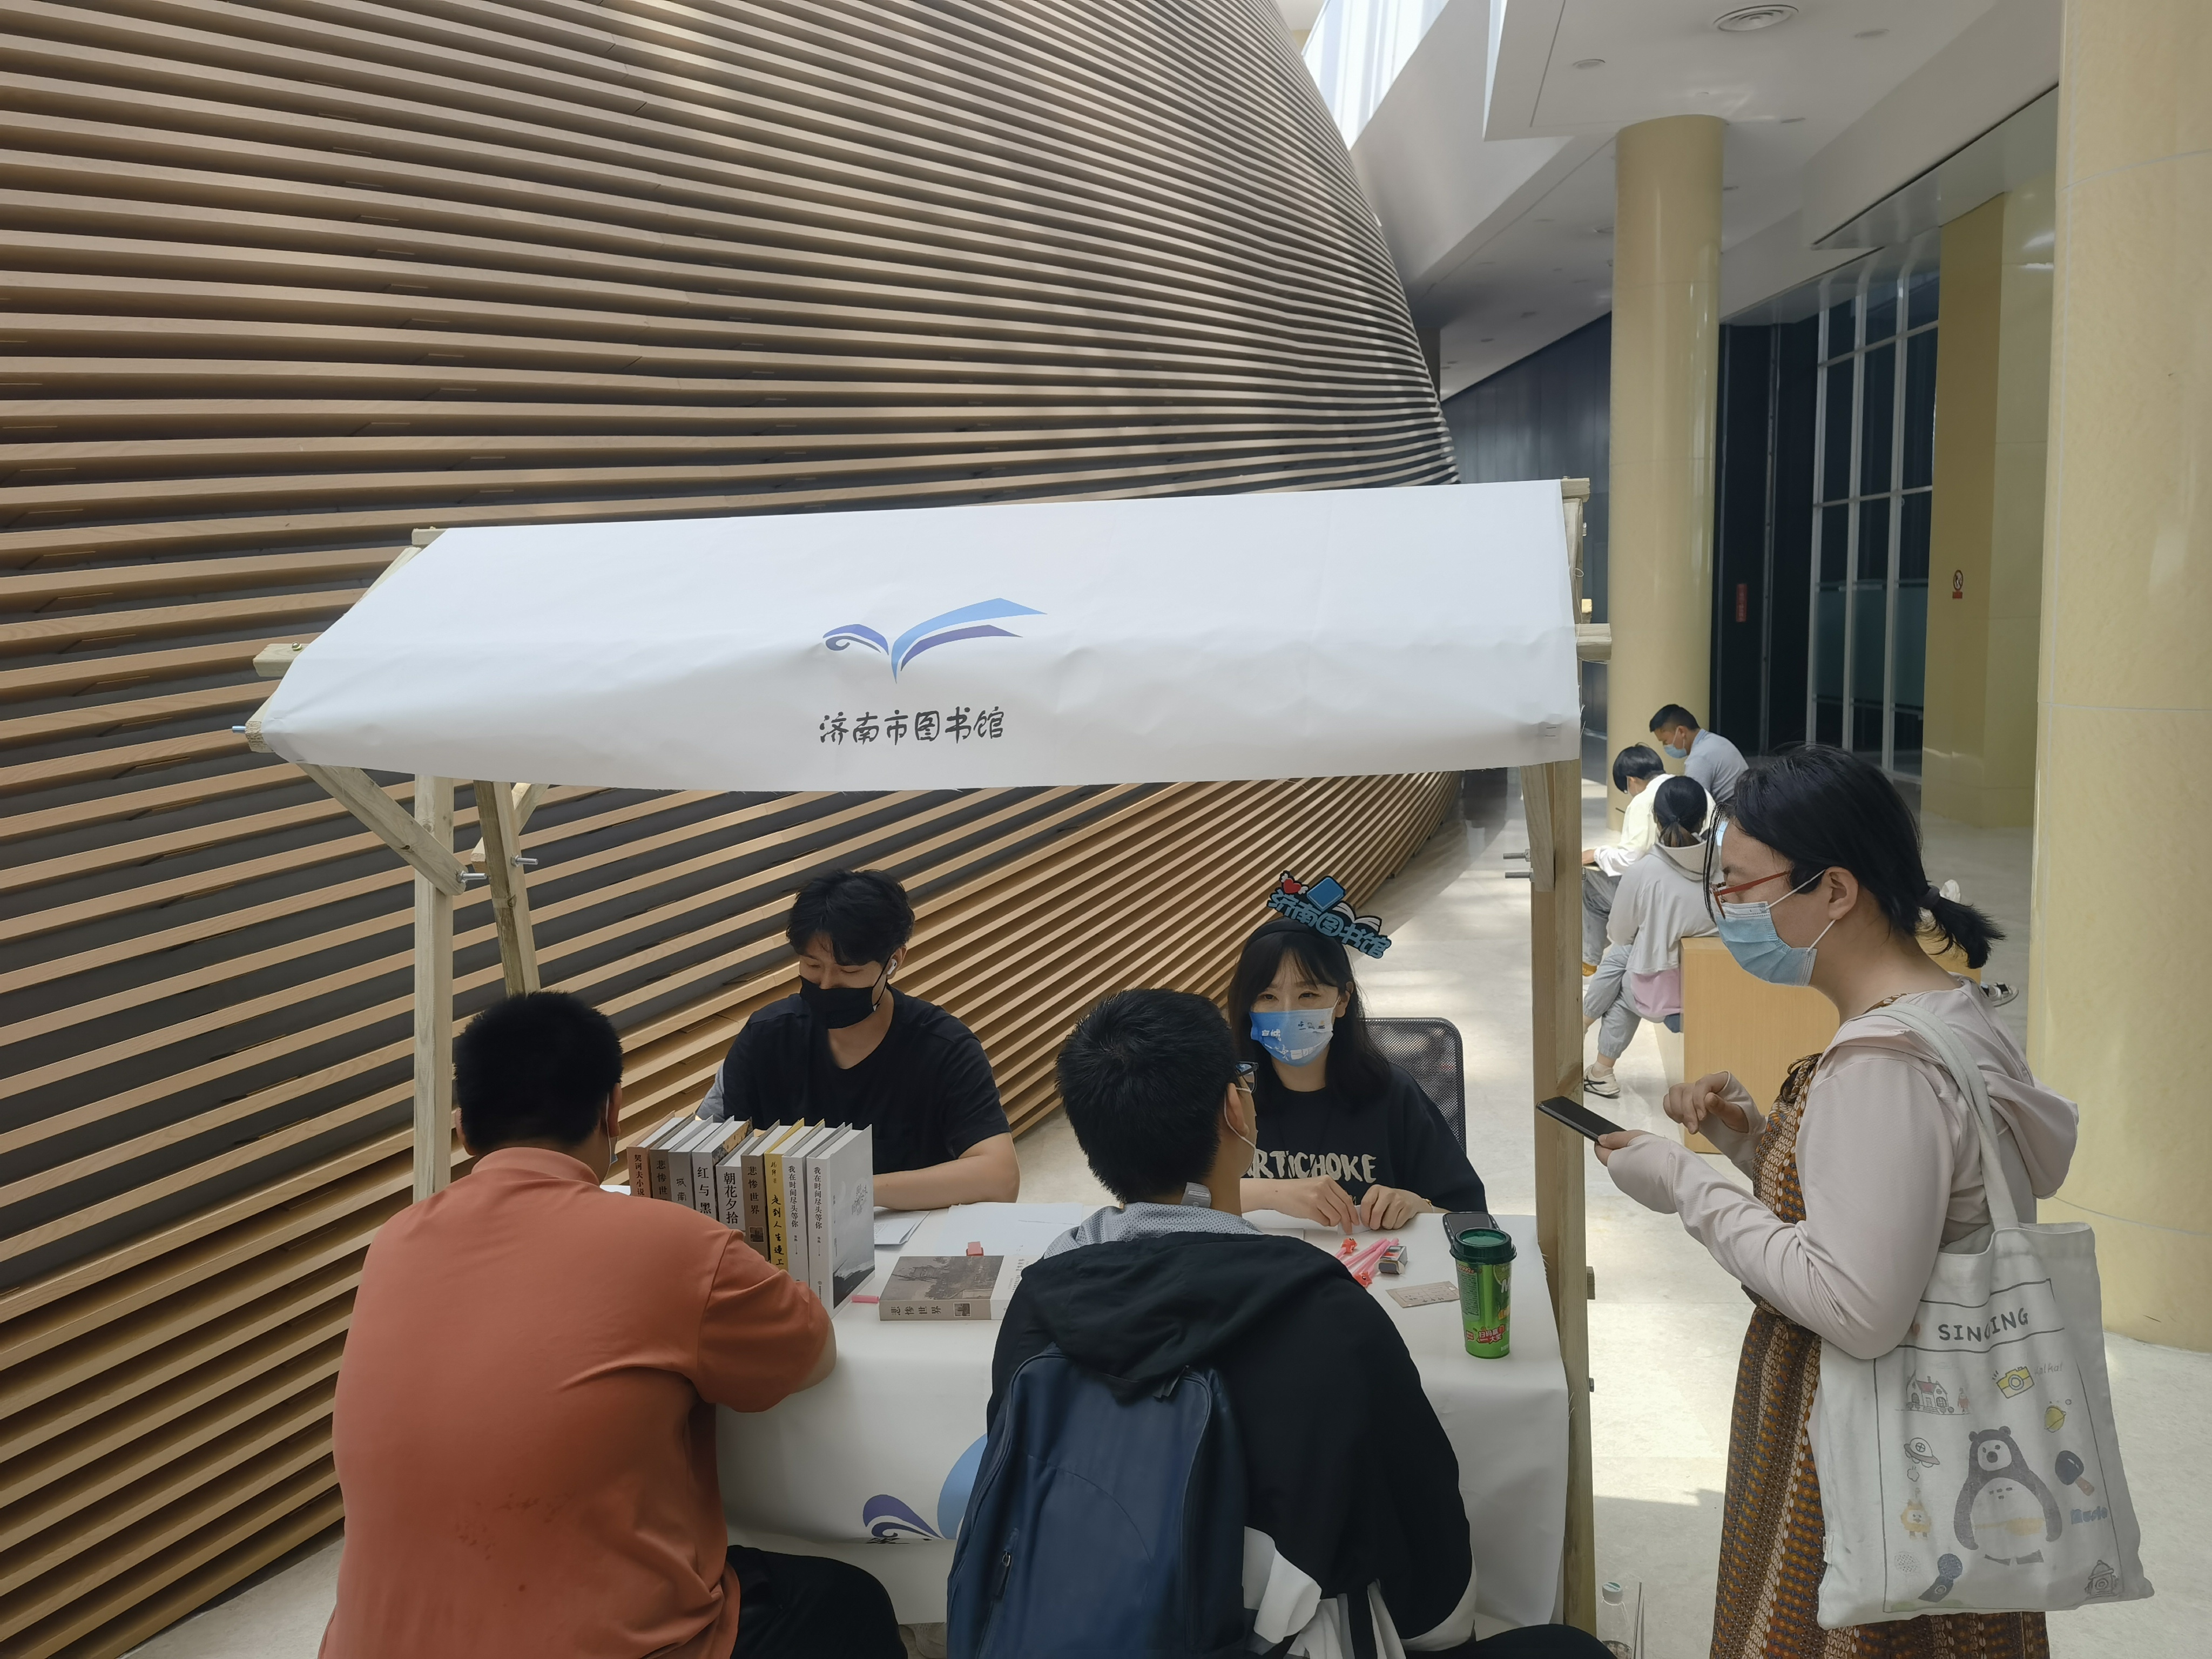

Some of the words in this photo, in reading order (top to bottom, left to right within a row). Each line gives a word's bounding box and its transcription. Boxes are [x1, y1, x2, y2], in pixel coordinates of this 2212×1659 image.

[819, 706, 1004, 745] 济南市图书馆
[1267, 888, 1391, 958] 济南图书馆
[634, 1154, 645, 1197] 契诃夫小说
[656, 1160, 668, 1201] 悲惨世
[1247, 1149, 1377, 1183] RTICHOKE
[676, 1178, 687, 1202] 城南
[697, 1166, 712, 1214] 红与黑
[723, 1172, 739, 1224] 朝花夕拾
[747, 1166, 760, 1215] 悲惨世界
[788, 1165, 799, 1228] 我在时间尽头等你
[813, 1166, 822, 1229] 我在时间尽头等你
[891, 1306, 941, 1316] 悲惨世界
